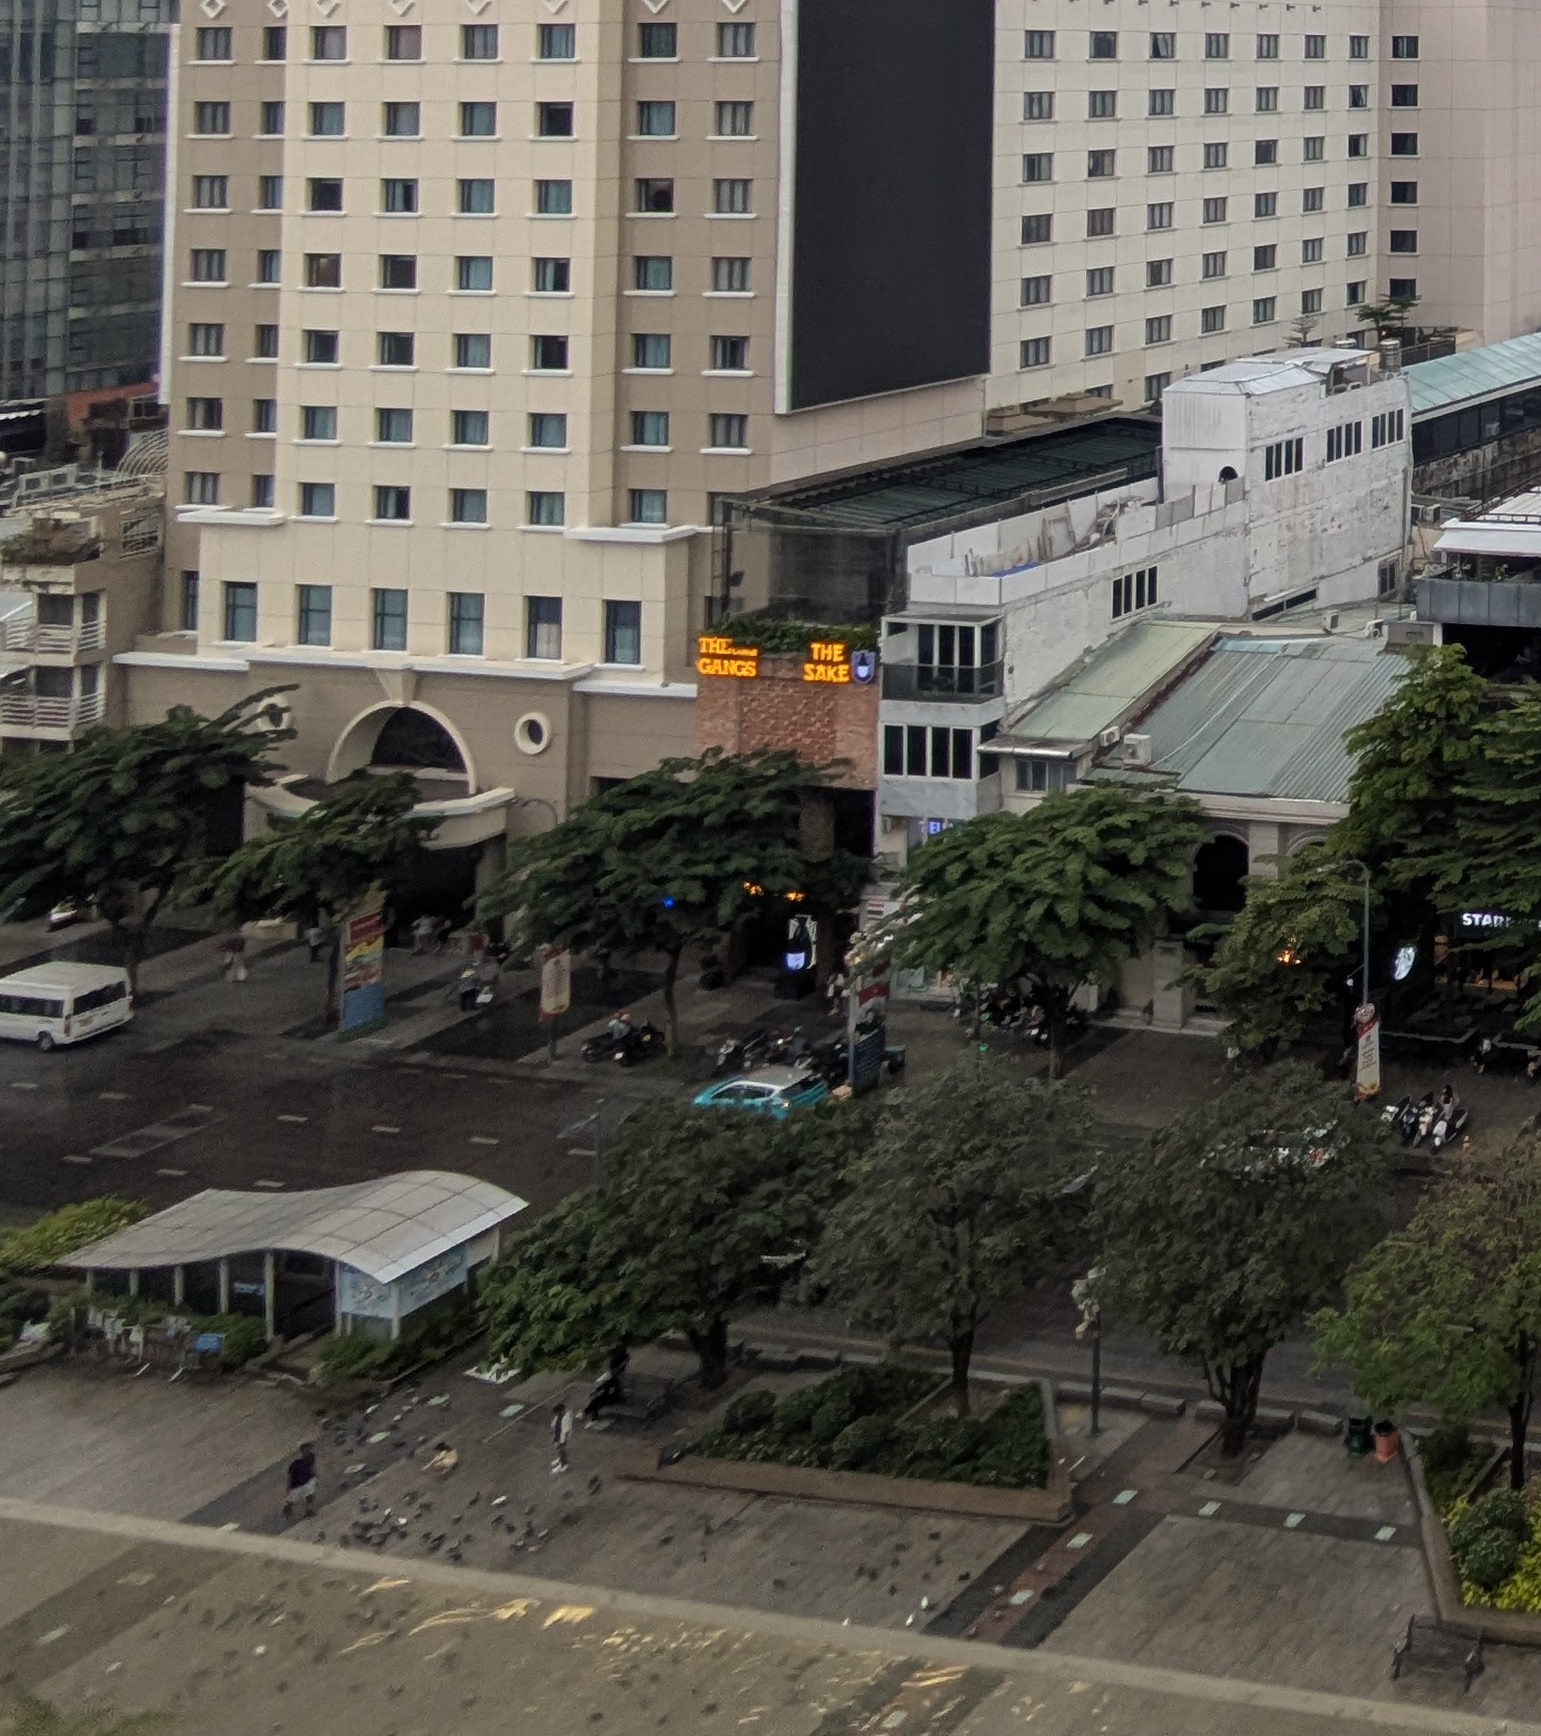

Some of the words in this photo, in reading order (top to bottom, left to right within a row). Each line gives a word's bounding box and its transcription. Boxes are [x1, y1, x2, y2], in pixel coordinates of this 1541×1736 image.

[699, 637, 732, 654] THE
[811, 643, 845, 662] THE
[698, 658, 757, 677] GANGS
[803, 664, 850, 683] SAKE
